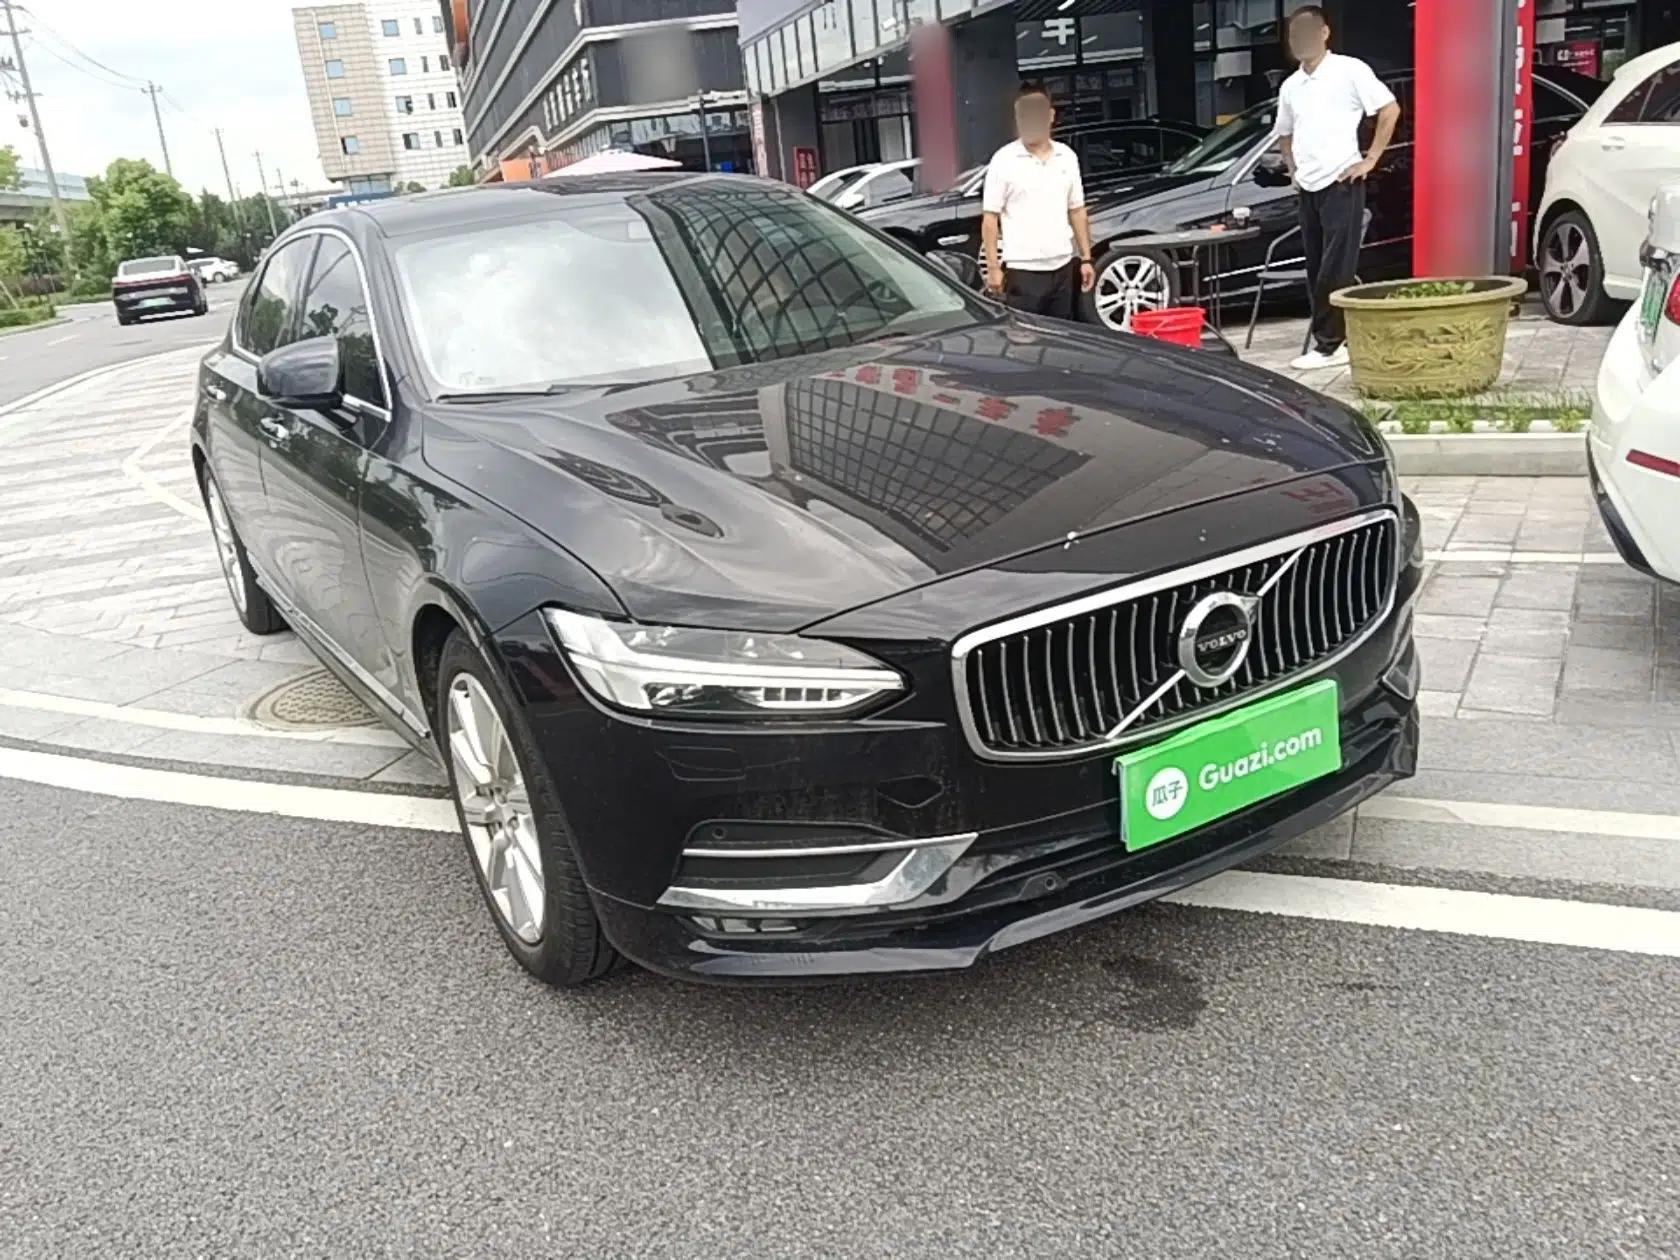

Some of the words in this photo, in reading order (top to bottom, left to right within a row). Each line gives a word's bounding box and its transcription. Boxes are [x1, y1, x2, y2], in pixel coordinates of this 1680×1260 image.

[1197, 629, 1247, 652] VOLVO
[1199, 727, 1323, 790] Guazi.com
[1151, 779, 1184, 807] 瓜子
